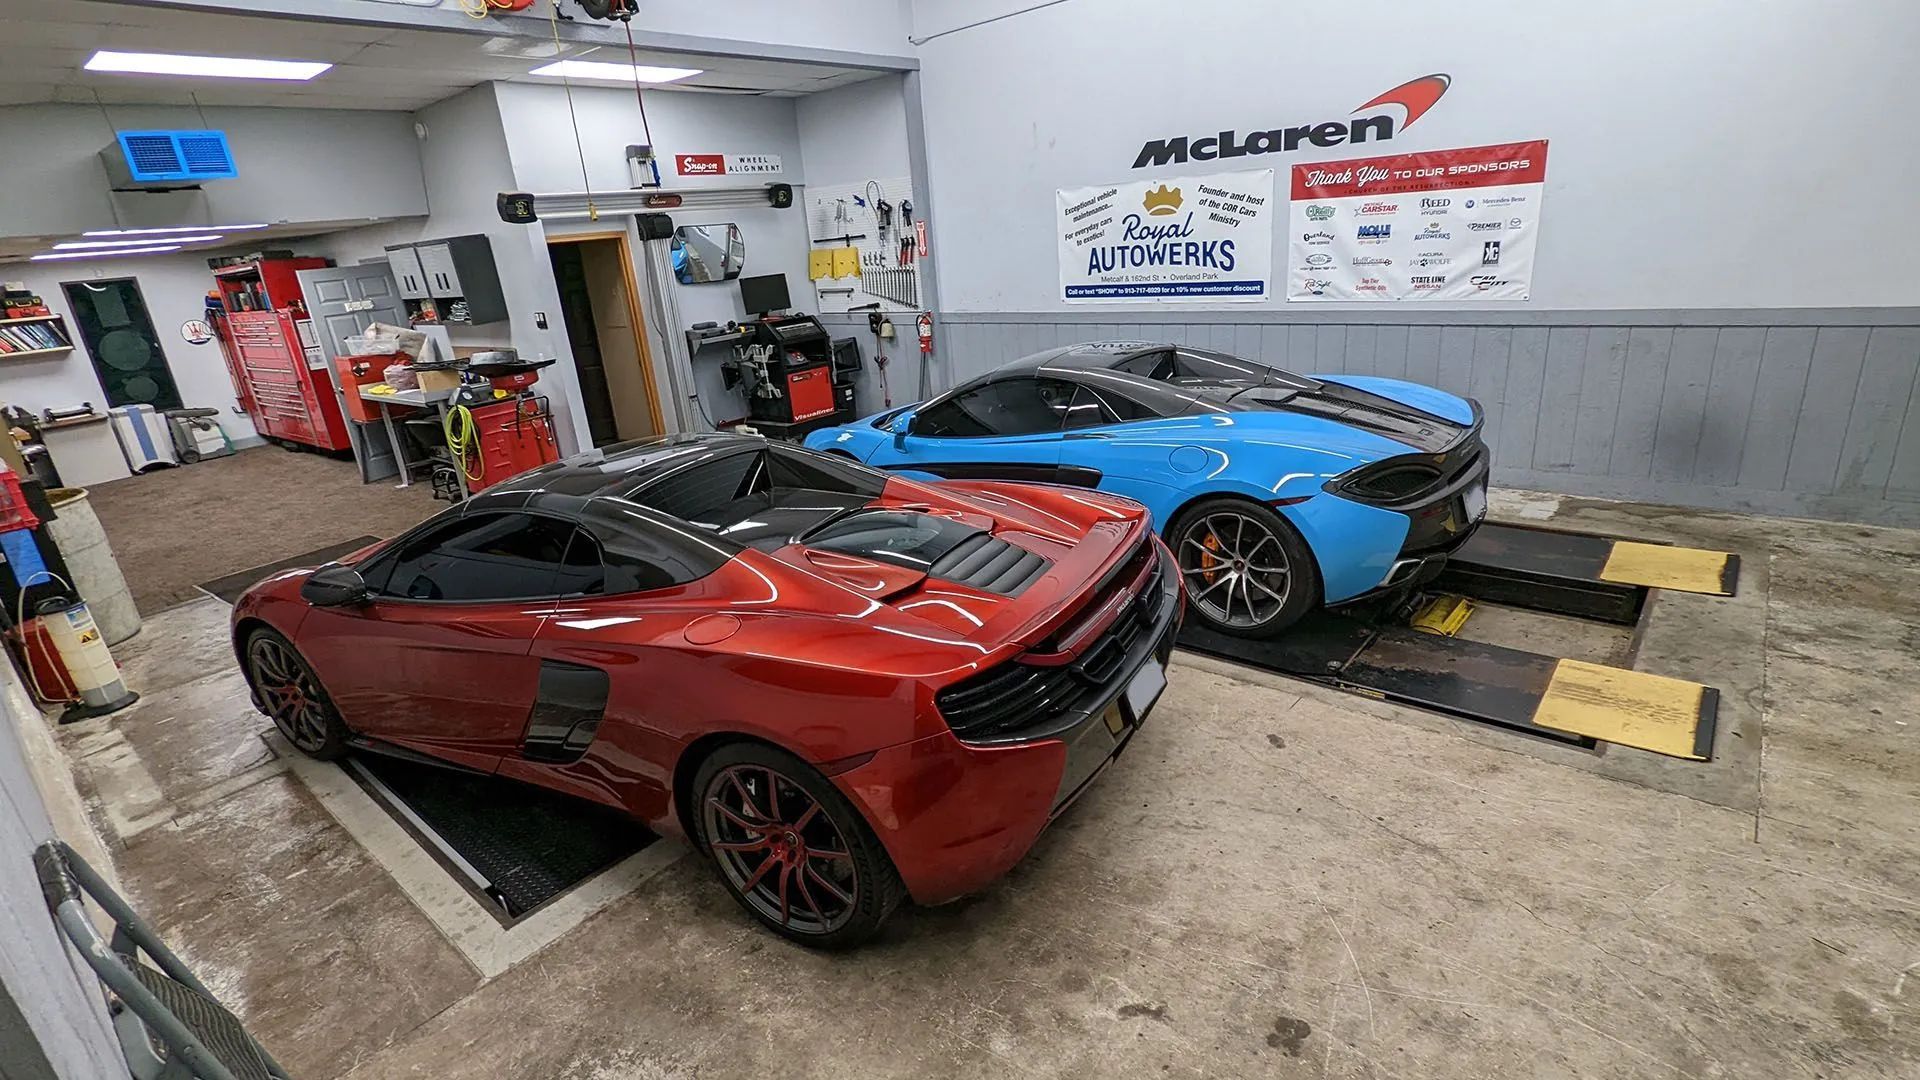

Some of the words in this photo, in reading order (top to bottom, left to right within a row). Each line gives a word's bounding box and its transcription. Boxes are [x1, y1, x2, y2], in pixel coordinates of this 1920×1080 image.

[1131, 115, 1393, 168] McLaren
[684, 156, 718, 173] Snap-on
[1305, 168, 1352, 188] Thank
[1356, 165, 1389, 187] You
[1393, 171, 1412, 179] TO
[1416, 168, 1445, 178] OUR
[1448, 160, 1531, 175] SPONSORS
[1065, 196, 1096, 216] Exceptional
[1097, 188, 1118, 202] vehicle
[1198, 184, 1229, 198] Founder
[1230, 192, 1246, 202] and
[1246, 194, 1265, 206] host
[1199, 198, 1208, 206] of
[1208, 199, 1221, 209] the
[1222, 202, 1239, 213] COR
[1239, 206, 1257, 217] Cars
[1362, 204, 1398, 213] CARSTAR
[1419, 198, 1451, 209] REED
[1208, 213, 1241, 228] Ministry
[1471, 222, 1502, 230] PREMIER
[1065, 232, 1075, 241] For
[1075, 222, 1099, 237] everyday
[1100, 217, 1113, 227] cars
[1122, 211, 1194, 249] Royal
[1358, 224, 1391, 235] MOLLE
[1083, 230, 1105, 244] exotics!
[1303, 231, 1335, 242] Overland
[1413, 232, 1451, 241] AUTOWERKS
[1088, 240, 1235, 276] AUTOWERKS
[1170, 273, 1201, 281] Overland
[1202, 272, 1219, 280] Park
[1411, 276, 1430, 284] STATE
[1431, 275, 1446, 284] LINE
[1232, 284, 1261, 292] discount
[794, 407, 835, 421] Visualiner
